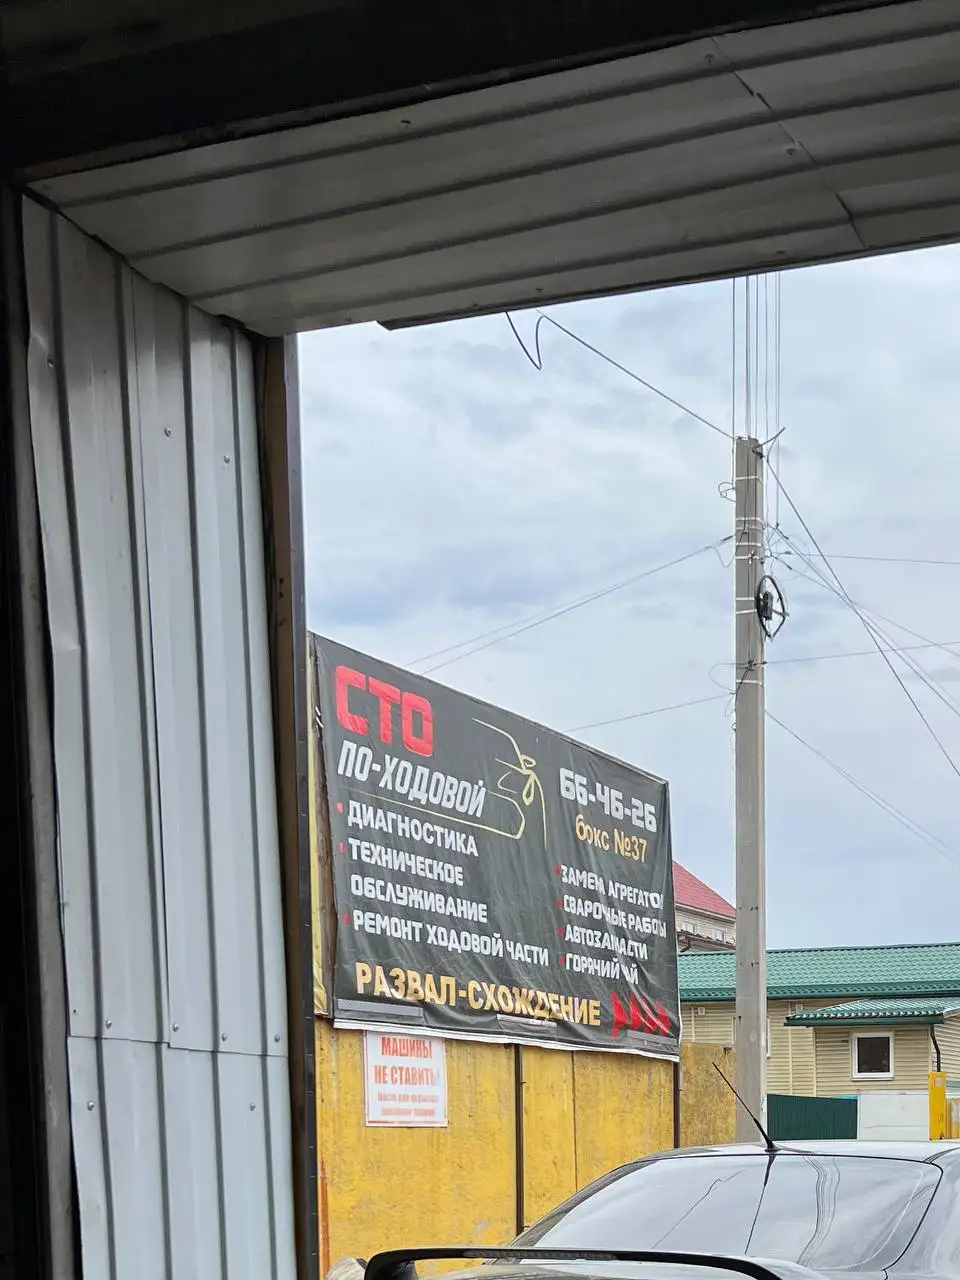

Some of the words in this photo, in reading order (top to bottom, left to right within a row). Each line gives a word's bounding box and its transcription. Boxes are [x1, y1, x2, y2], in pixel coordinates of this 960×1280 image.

[335, 665, 434, 758] СТО
[337, 739, 487, 818] ПО-ХОДОВОЙ
[560, 767, 657, 833] 66-46-26
[347, 800, 479, 858] ДИАГНОСТИКА
[575, 814, 610, 851] бокс
[613, 828, 647, 863] №37
[348, 837, 464, 887] ТЕХНИЧЕСКОЕ
[350, 874, 488, 924] ОБСЛУЖИВАНИЕ
[352, 909, 423, 943] РЕМОНТ
[426, 923, 504, 958] ХОДОВОЙ
[505, 939, 549, 967] ЧАСТИ
[628, 913, 667, 938] РАБОЫ
[565, 953, 620, 980] ГОРЯЧИЙ
[355, 962, 601, 1026] РАЗВАЛ-СХОЖДЕНИЕ
[381, 1036, 432, 1059] МАШИНЫ
[374, 1065, 388, 1084] НЕ
